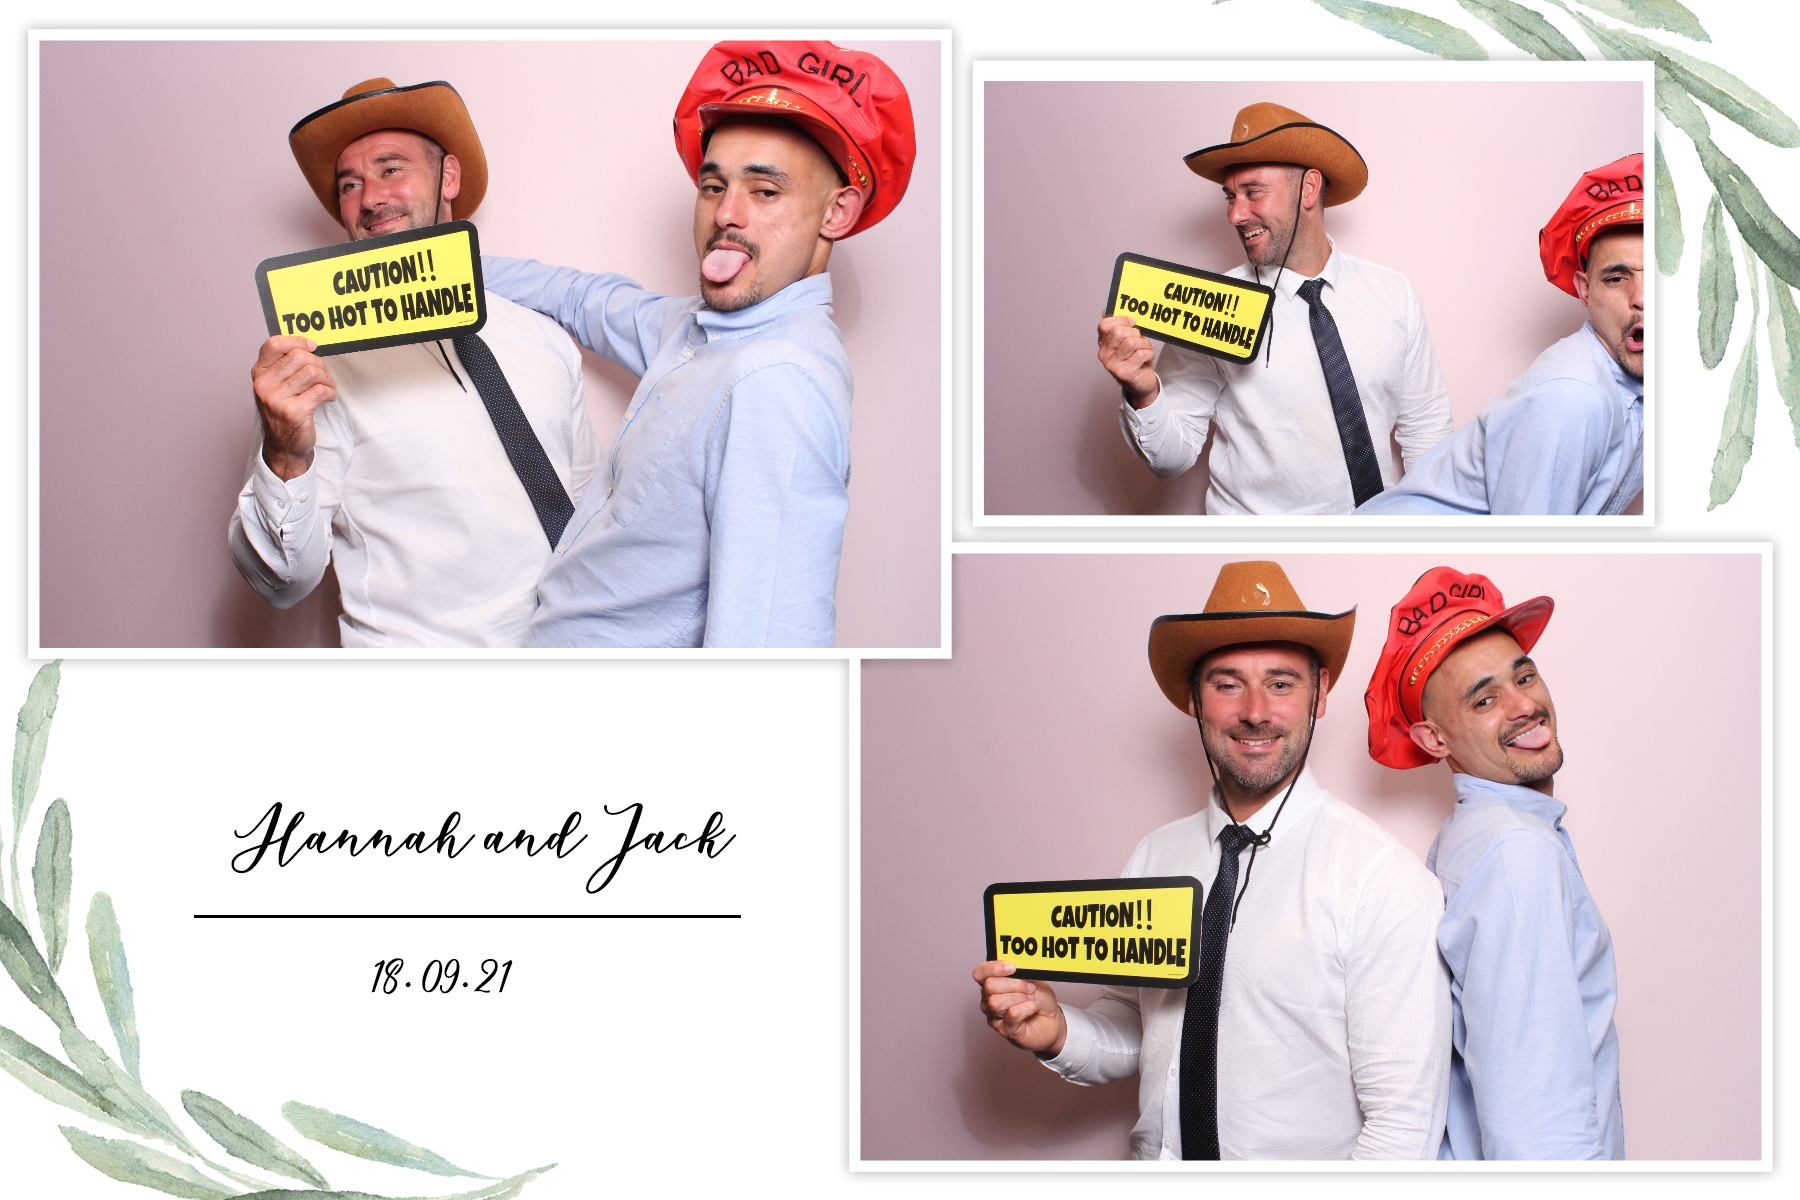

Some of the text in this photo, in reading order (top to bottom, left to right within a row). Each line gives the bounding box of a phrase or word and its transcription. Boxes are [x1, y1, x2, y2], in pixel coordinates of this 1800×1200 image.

[720, 50, 866, 109] BAD GIRL
[1585, 174, 1643, 202] BAD
[333, 249, 437, 296] CAUTION!!
[282, 283, 474, 335] TOO HOT TO HANDLE
[1119, 293, 1256, 350] TOO HOT TO HANDLE
[1163, 282, 1240, 318] CAUTION!!
[1397, 591, 1448, 635] BAD
[1051, 899, 1152, 931] CAUTION!!
[1000, 935, 1187, 967] TOO HOT TO HANDLE
